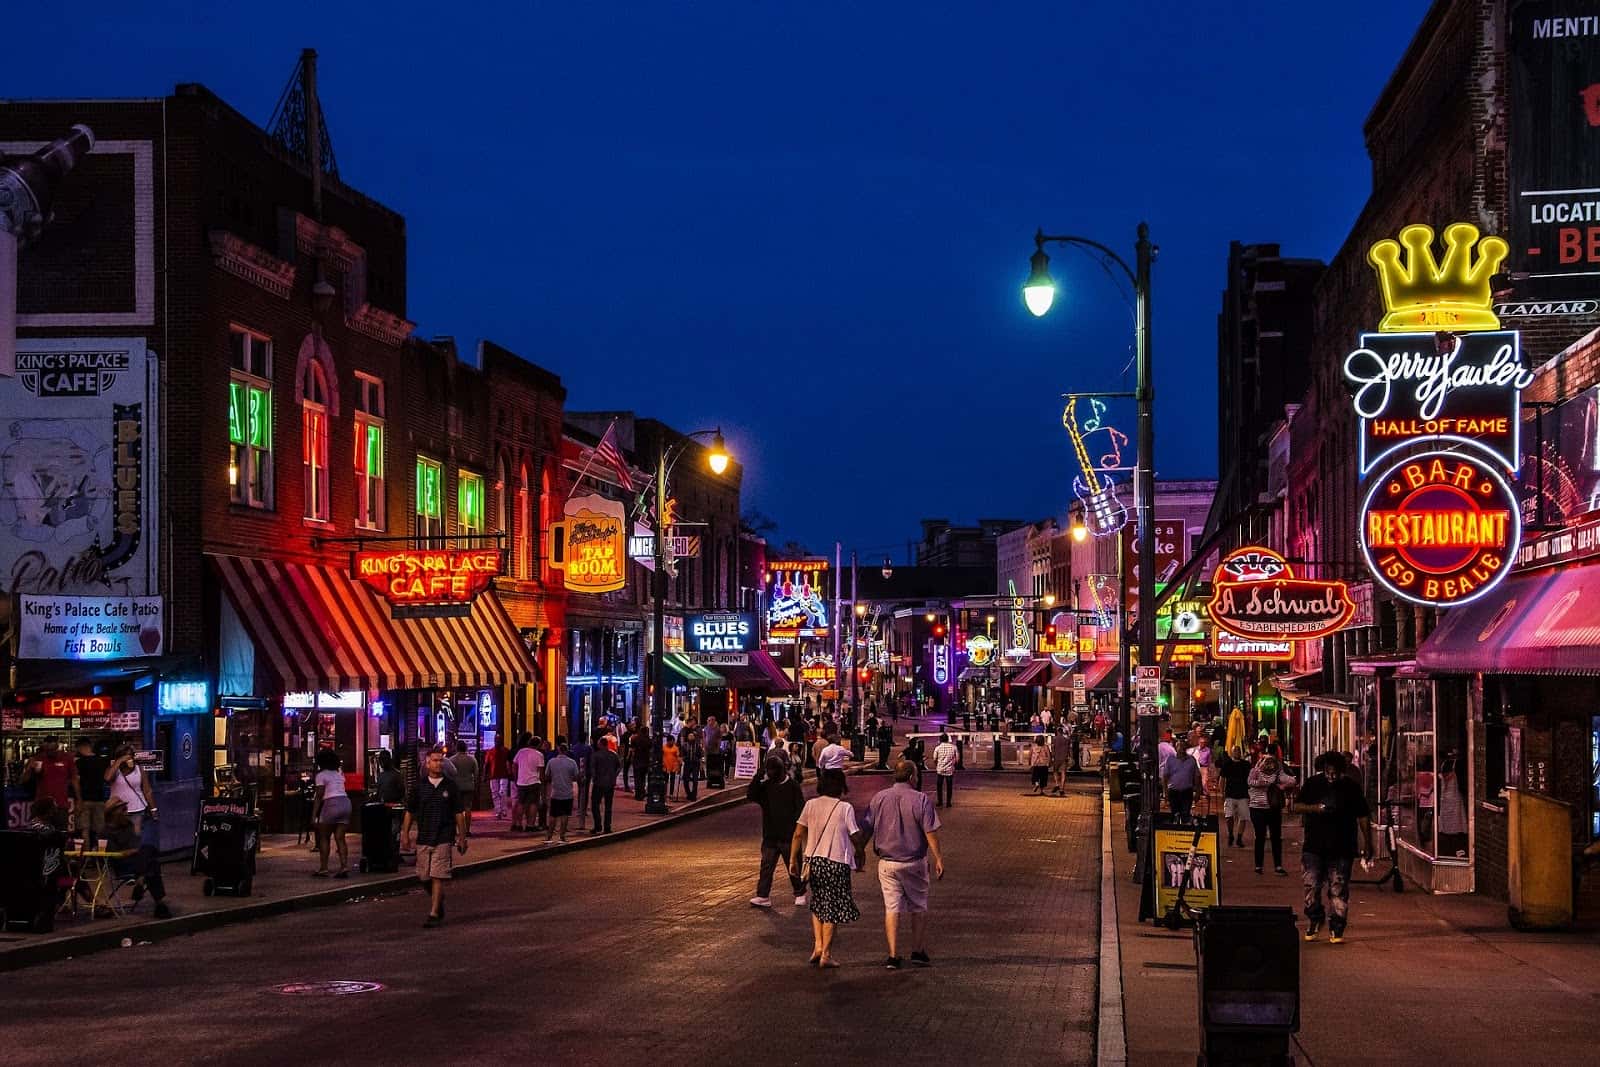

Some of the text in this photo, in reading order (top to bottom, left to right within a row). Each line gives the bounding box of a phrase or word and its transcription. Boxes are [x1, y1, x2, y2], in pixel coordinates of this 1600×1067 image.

[1559, 225, 1600, 265] BE
[1498, 302, 1588, 315] LAMAR
[16, 353, 121, 369] KING'S PALACE
[42, 373, 98, 393] CAFE
[1344, 336, 1536, 421] Jerry Lawler
[1373, 418, 1507, 435] HALL OF FAME
[116, 419, 139, 534] BLUES
[1403, 459, 1475, 489] BAR
[1166, 527, 1174, 535] a
[1368, 511, 1510, 547] RESTAURANT
[583, 547, 616, 560] TAP
[1131, 537, 1175, 555] Cke
[361, 554, 498, 574] KING'S PALACE
[570, 560, 617, 576] ROOM
[1224, 553, 1284, 576] PIG
[1379, 553, 1502, 599] 159 BEALE
[391, 576, 468, 597] CAFE
[24, 600, 160, 617] King's Palace Cafe Patio
[1215, 587, 1243, 615] A.
[1246, 586, 1344, 615] Schwab
[44, 621, 141, 635] Home of the Beale Street
[693, 621, 750, 636] BLUES
[1240, 620, 1306, 633] ESTABLISHED
[63, 638, 122, 655] Fish Bowls
[699, 637, 744, 650] HALL
[718, 655, 743, 663] JOINT
[1141, 668, 1156, 677] NO
[50, 697, 105, 716] PATIO
